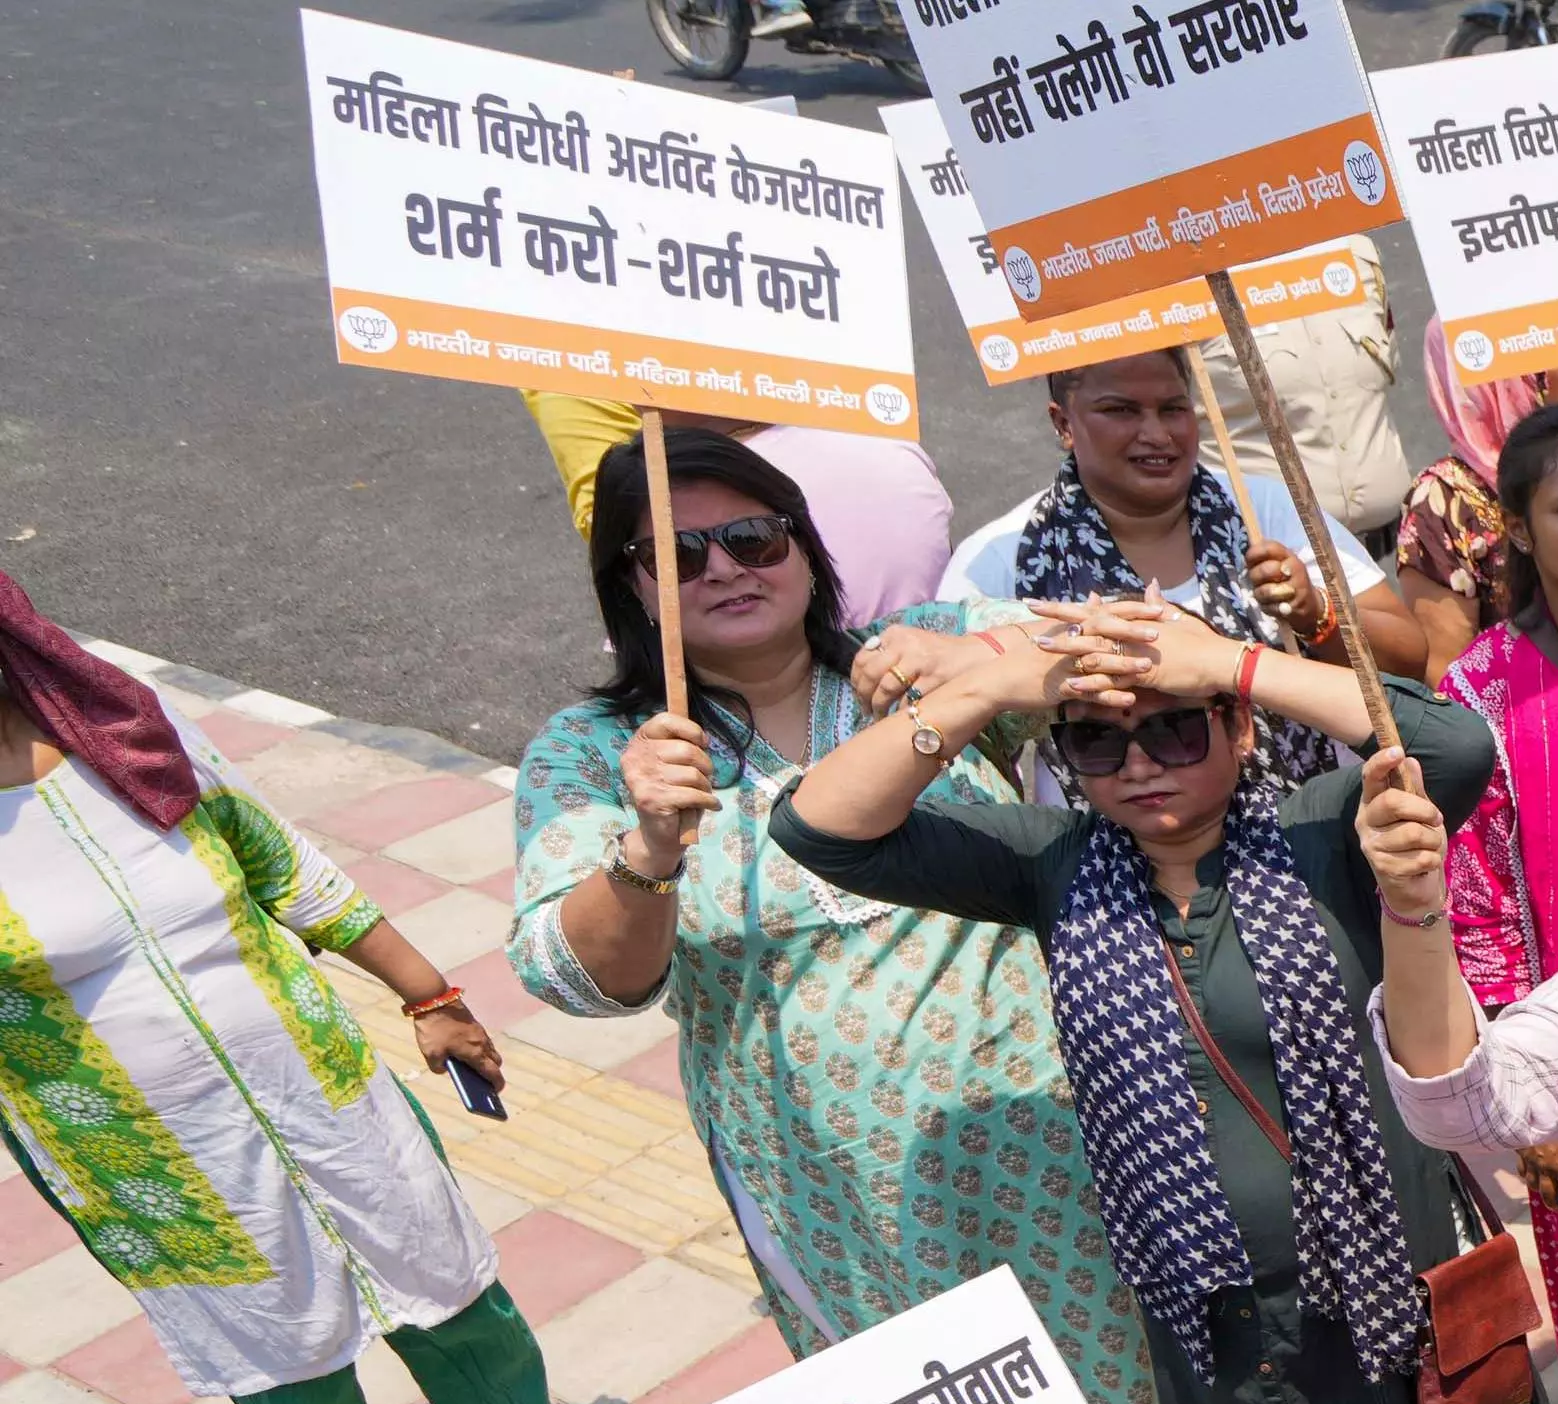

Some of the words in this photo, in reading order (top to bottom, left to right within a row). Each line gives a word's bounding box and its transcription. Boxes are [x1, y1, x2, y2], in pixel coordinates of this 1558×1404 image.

[959, 55, 1035, 143] नहीं
[1026, 20, 1136, 122] चलेगी
[1122, 4, 1175, 88] वो
[1167, 0, 1308, 74] सरकार
[326, 71, 461, 149] महिला
[472, 93, 590, 174] विरोधी
[605, 131, 716, 198] अरविंद
[726, 144, 884, 229] केजरीवाल
[1408, 118, 1502, 174] महिला
[405, 186, 503, 267] शर्म
[750, 246, 840, 322] करो
[406, 329, 491, 358] भारतीय
[495, 342, 563, 368] जनता
[624, 357, 691, 386] महिला
[754, 374, 811, 403] दिल्ली
[813, 385, 861, 409] प्रदेश
